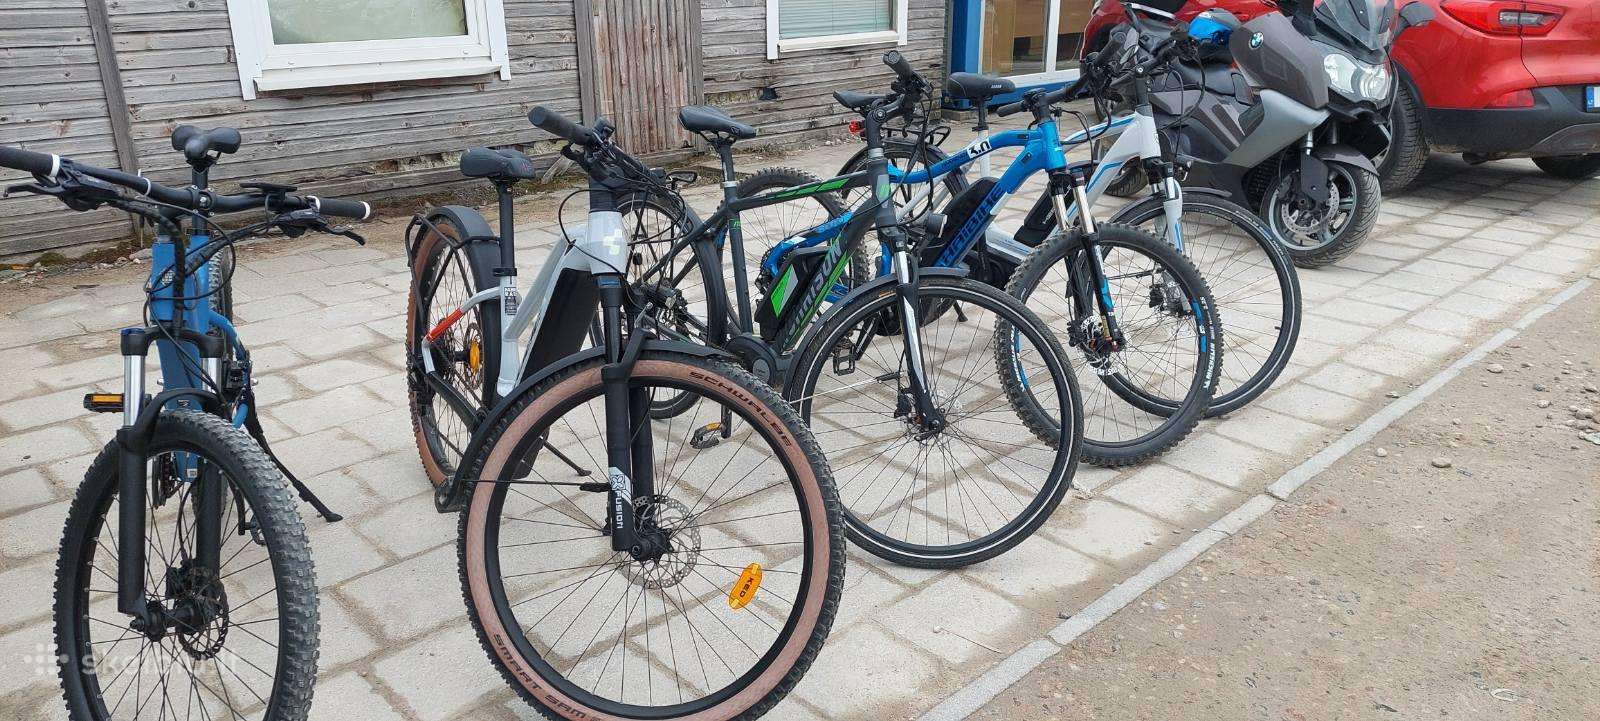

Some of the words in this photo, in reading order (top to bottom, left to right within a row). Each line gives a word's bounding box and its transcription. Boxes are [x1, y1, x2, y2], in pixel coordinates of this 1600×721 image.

[688, 371, 792, 447] SCHWALBE
[615, 490, 624, 529] FUSION
[739, 576, 754, 598] KED
[493, 634, 542, 690] SMART
[544, 695, 586, 719] SAM
